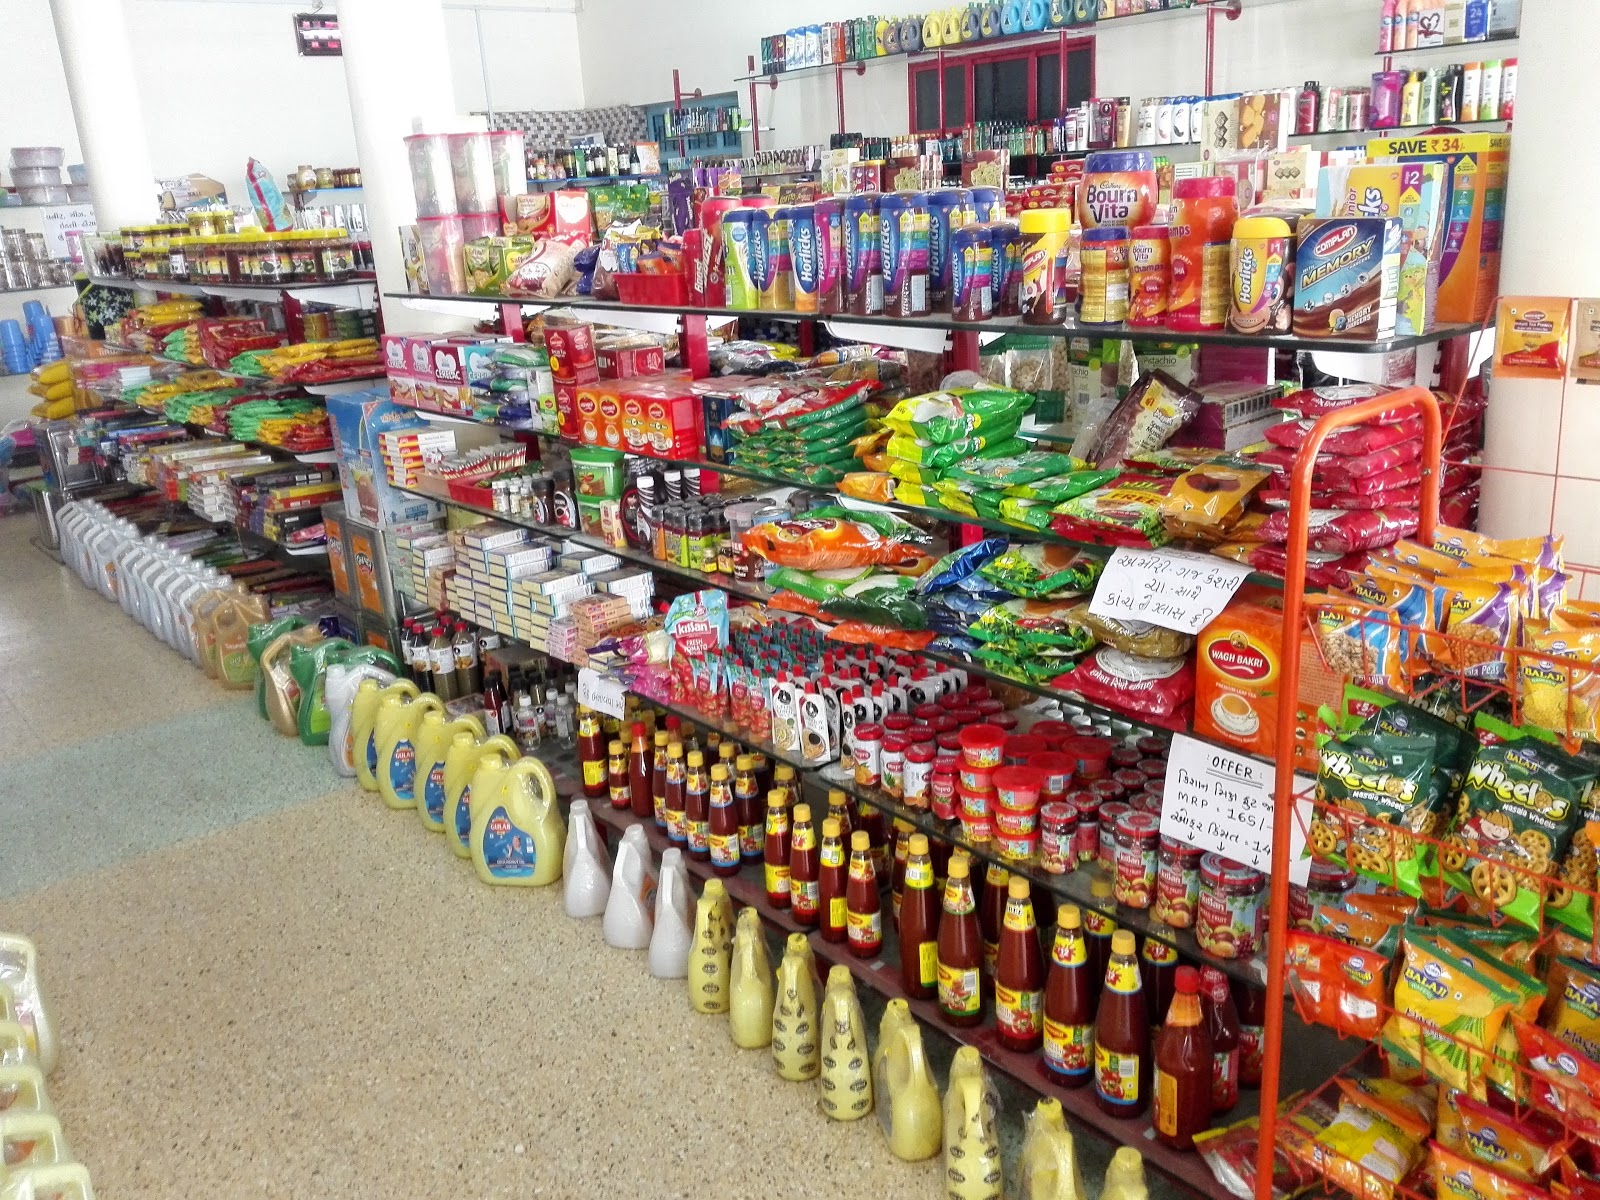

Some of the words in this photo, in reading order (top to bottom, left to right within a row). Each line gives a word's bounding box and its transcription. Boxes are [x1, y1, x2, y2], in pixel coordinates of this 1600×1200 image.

[1389, 139, 1427, 155] SAVE
[1410, 171, 1420, 185] 2
[1087, 184, 1138, 204] Bourn
[1089, 204, 1129, 224] Vita
[1315, 224, 1355, 254] COMPLAN
[798, 227, 813, 282] Horlicks
[882, 218, 891, 281] Horlicks
[1133, 244, 1153, 255] Bourn
[1134, 254, 1149, 262] Vita
[1302, 238, 1374, 287] MEMORY
[1239, 247, 1254, 305] Horlicks
[1334, 316, 1347, 331] 8
[387, 359, 407, 371] CERELAC
[1143, 355, 1177, 366] Pistachio
[435, 369, 461, 381] CERELAC
[1111, 494, 1158, 507] FREE
[1433, 542, 1469, 558] BALAJI
[1356, 585, 1387, 604] BALAJI
[1320, 610, 1344, 621] LAJI
[1211, 649, 1236, 664] WAGH
[1237, 654, 1264, 669] BAKRI
[1481, 664, 1499, 676] Peas
[1524, 668, 1564, 682] BALAJI
[1215, 681, 1237, 693] PREMIUM
[1249, 691, 1257, 699] TEA
[1212, 756, 1253, 779] OFFER
[1506, 751, 1539, 771] BALAJI
[1466, 759, 1568, 820] Wheelos
[1178, 791, 1208, 808] MRP
[1352, 790, 1378, 801] Masala
[1380, 797, 1405, 813] Wheels
[1502, 803, 1528, 817] Masala
[1529, 811, 1556, 830] Wheels
[490, 822, 512, 832] GULAB
[1212, 913, 1228, 925] FRUIT
[1404, 968, 1448, 997] BALAJI
